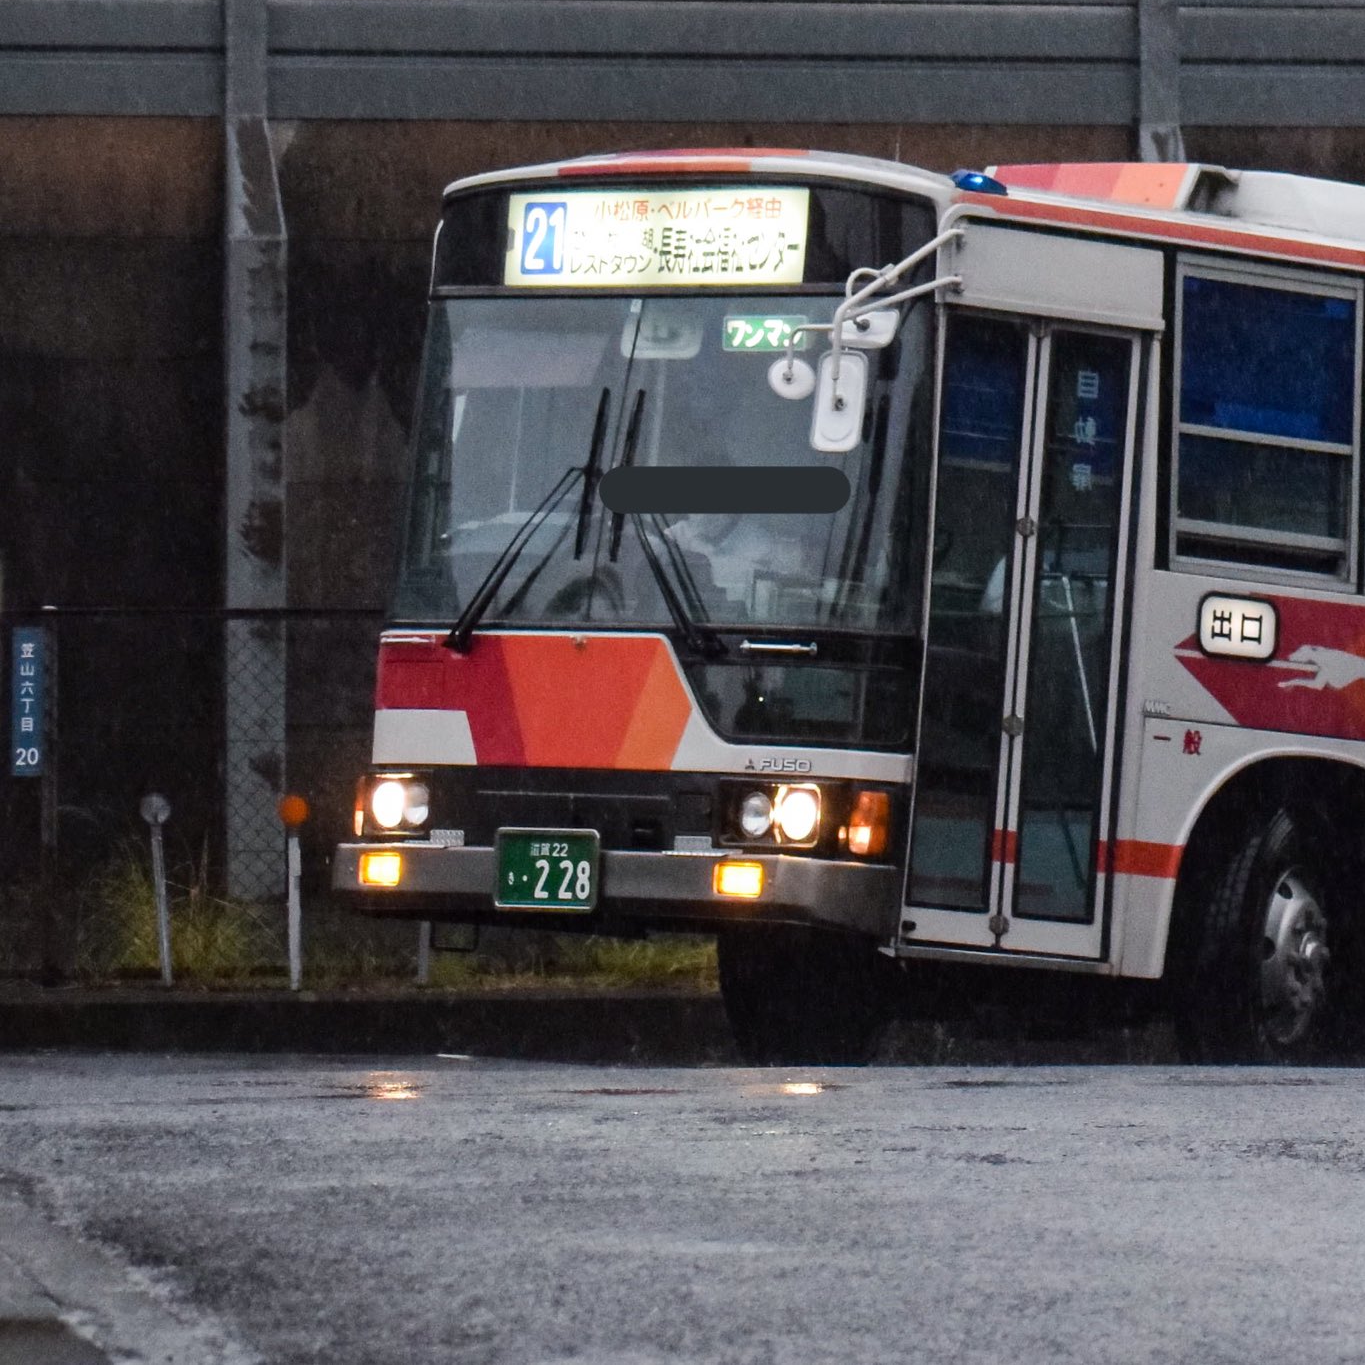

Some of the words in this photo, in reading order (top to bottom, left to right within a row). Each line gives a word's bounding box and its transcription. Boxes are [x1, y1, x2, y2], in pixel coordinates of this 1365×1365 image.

[523, 206, 566, 271] 21
[569, 253, 652, 274] レストタウン
[726, 319, 803, 348] ワンマン
[1210, 608, 1263, 646] 出口
[20, 643, 35, 732] 笠山六丁目
[15, 747, 39, 766] 20
[1153, 729, 1203, 756] 一般
[760, 758, 812, 773] FUSO
